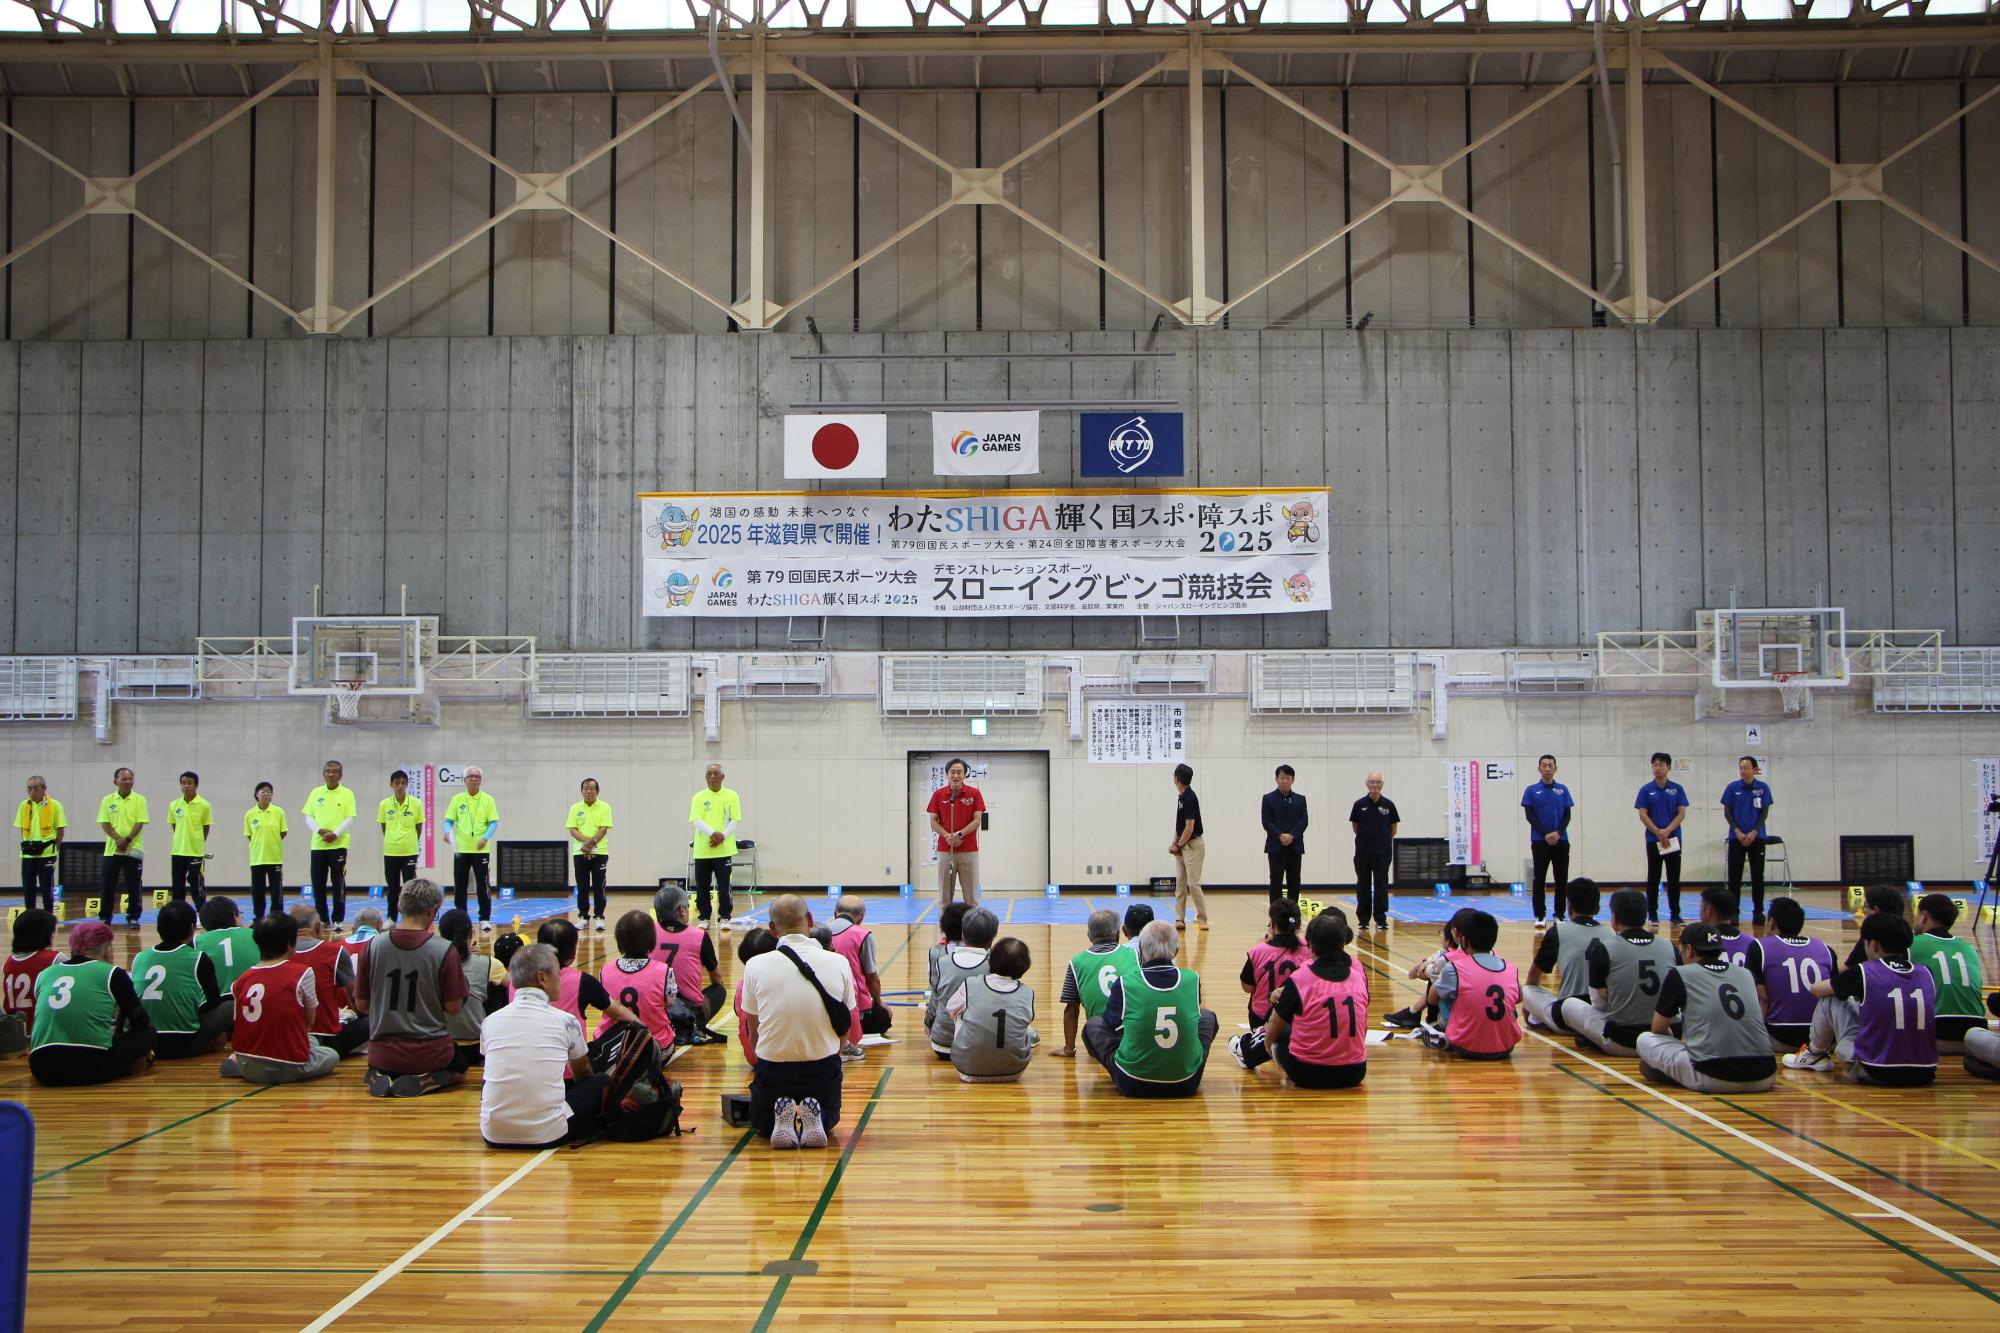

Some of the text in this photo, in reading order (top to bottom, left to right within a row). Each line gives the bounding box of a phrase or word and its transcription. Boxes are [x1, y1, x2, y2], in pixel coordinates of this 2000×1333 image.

[982, 433, 1021, 442] JAPAN
[982, 443, 1021, 452] GAMES
[710, 505, 869, 518] 湖国の感動 未来へつなぐ
[747, 569, 917, 585] 第79回国民スポーツ大会
[933, 563, 1092, 575] デモンストレーションスポーツ
[707, 591, 737, 599] JAPAN
[884, 594, 918, 605] 2025
[932, 571, 1272, 601] スローイングビンゴ競技会
[707, 599, 737, 607] GAMES
[1748, 727, 1758, 737] A
[1487, 764, 1514, 779] Eコート
[1119, 885, 1127, 893] O
[219, 937, 233, 967] 1
[1707, 933, 1718, 943] K
[660, 943, 680, 967] 7
[1932, 951, 1970, 987] 11
[5, 973, 33, 1008] 12
[142, 964, 167, 1000] 2
[387, 968, 419, 1013] 11
[1098, 965, 1121, 998] 6
[1638, 959, 1661, 997] 5
[1782, 957, 1822, 993] 10
[48, 975, 75, 1010] 3
[242, 983, 266, 1022] 3
[1485, 984, 1505, 1022] 3
[1718, 983, 1745, 1021] 6
[1322, 995, 1356, 1039] 11
[1887, 987, 1926, 1030] 11
[992, 1008, 1007, 1049] 1
[1154, 1006, 1179, 1049] 5
